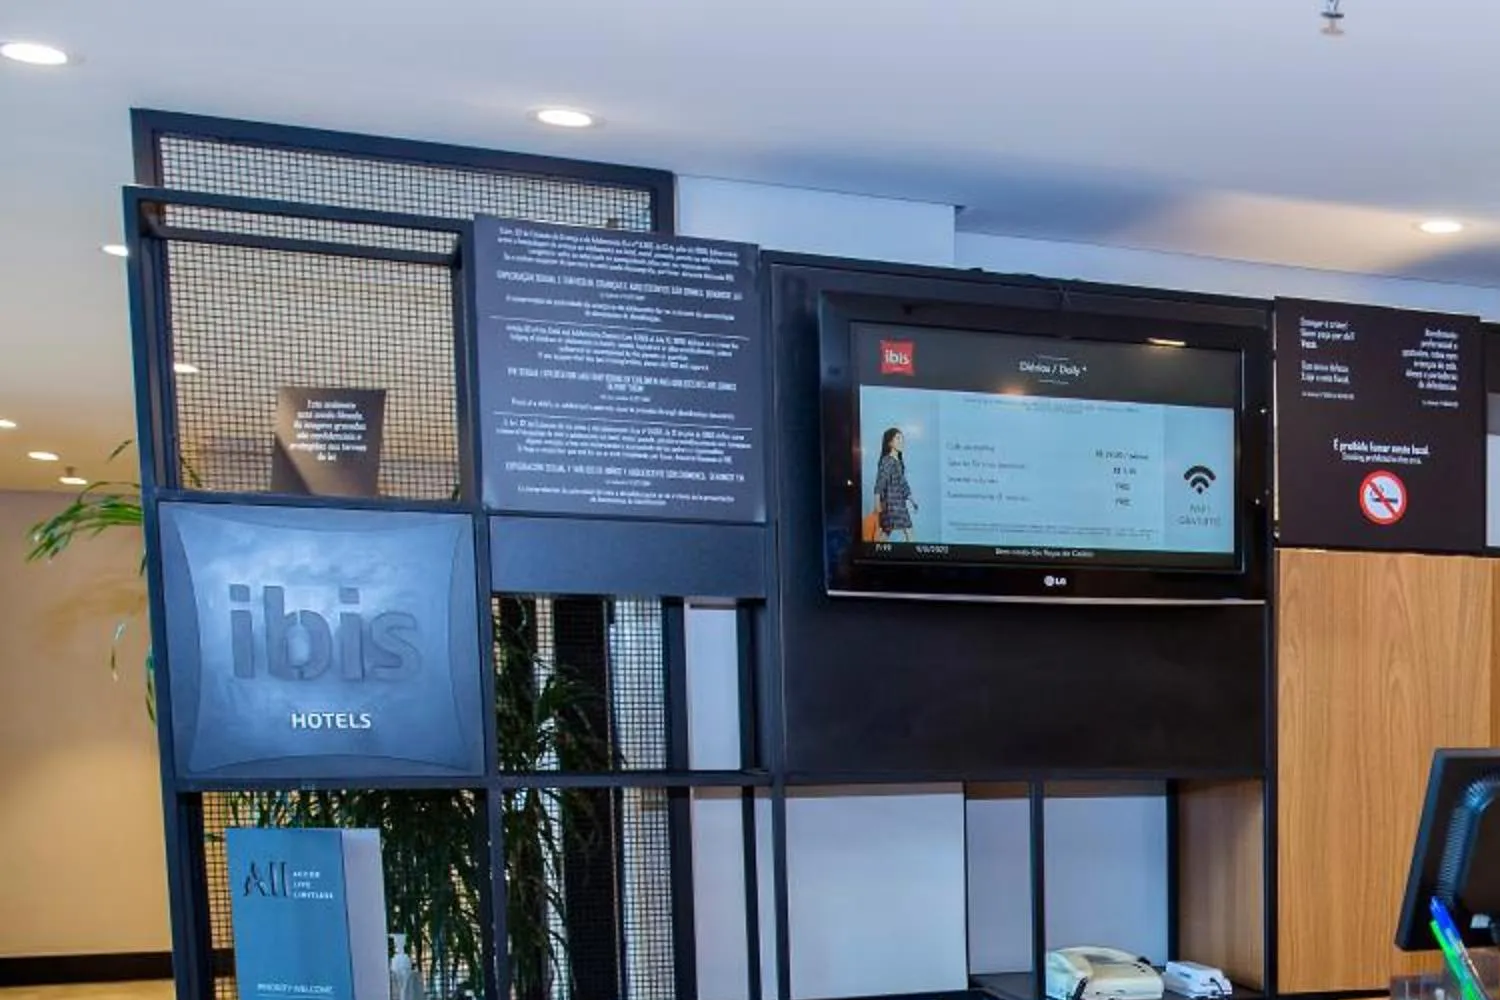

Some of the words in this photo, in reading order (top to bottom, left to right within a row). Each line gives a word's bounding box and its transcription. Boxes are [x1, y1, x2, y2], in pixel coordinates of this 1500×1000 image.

[885, 349, 911, 365] ibis
[1055, 577, 1067, 585] LG
[229, 583, 422, 683] ibis
[291, 712, 372, 729] HOTELS
